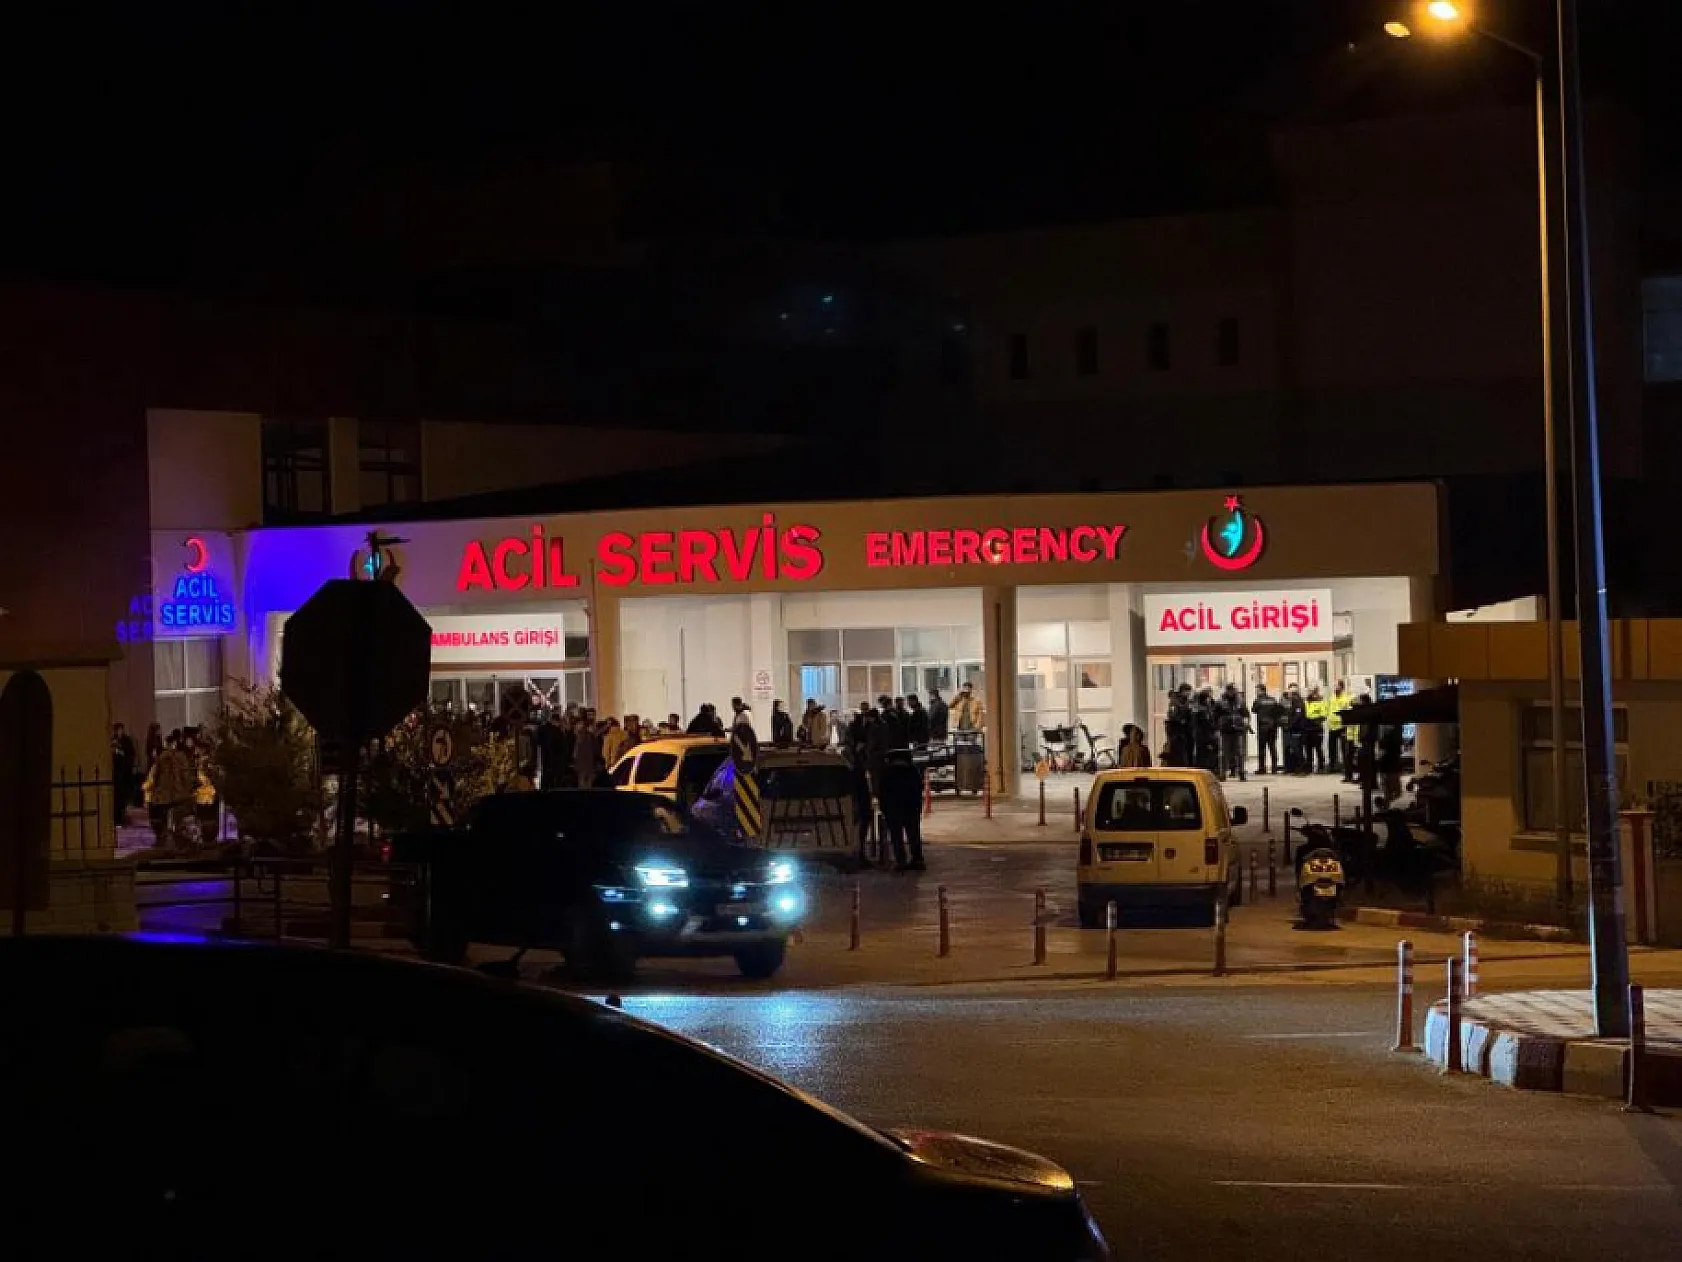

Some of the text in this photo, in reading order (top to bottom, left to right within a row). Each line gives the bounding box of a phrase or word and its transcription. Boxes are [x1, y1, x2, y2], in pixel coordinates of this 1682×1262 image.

[456, 512, 824, 593] ACİL SERVİS
[865, 524, 1127, 567] EMERGENCY
[173, 573, 218, 598] ACİL
[161, 601, 234, 626] SERVİS
[1158, 600, 1320, 633] ACİL GİRİŞİ
[513, 628, 560, 647] GİRİŞİ
